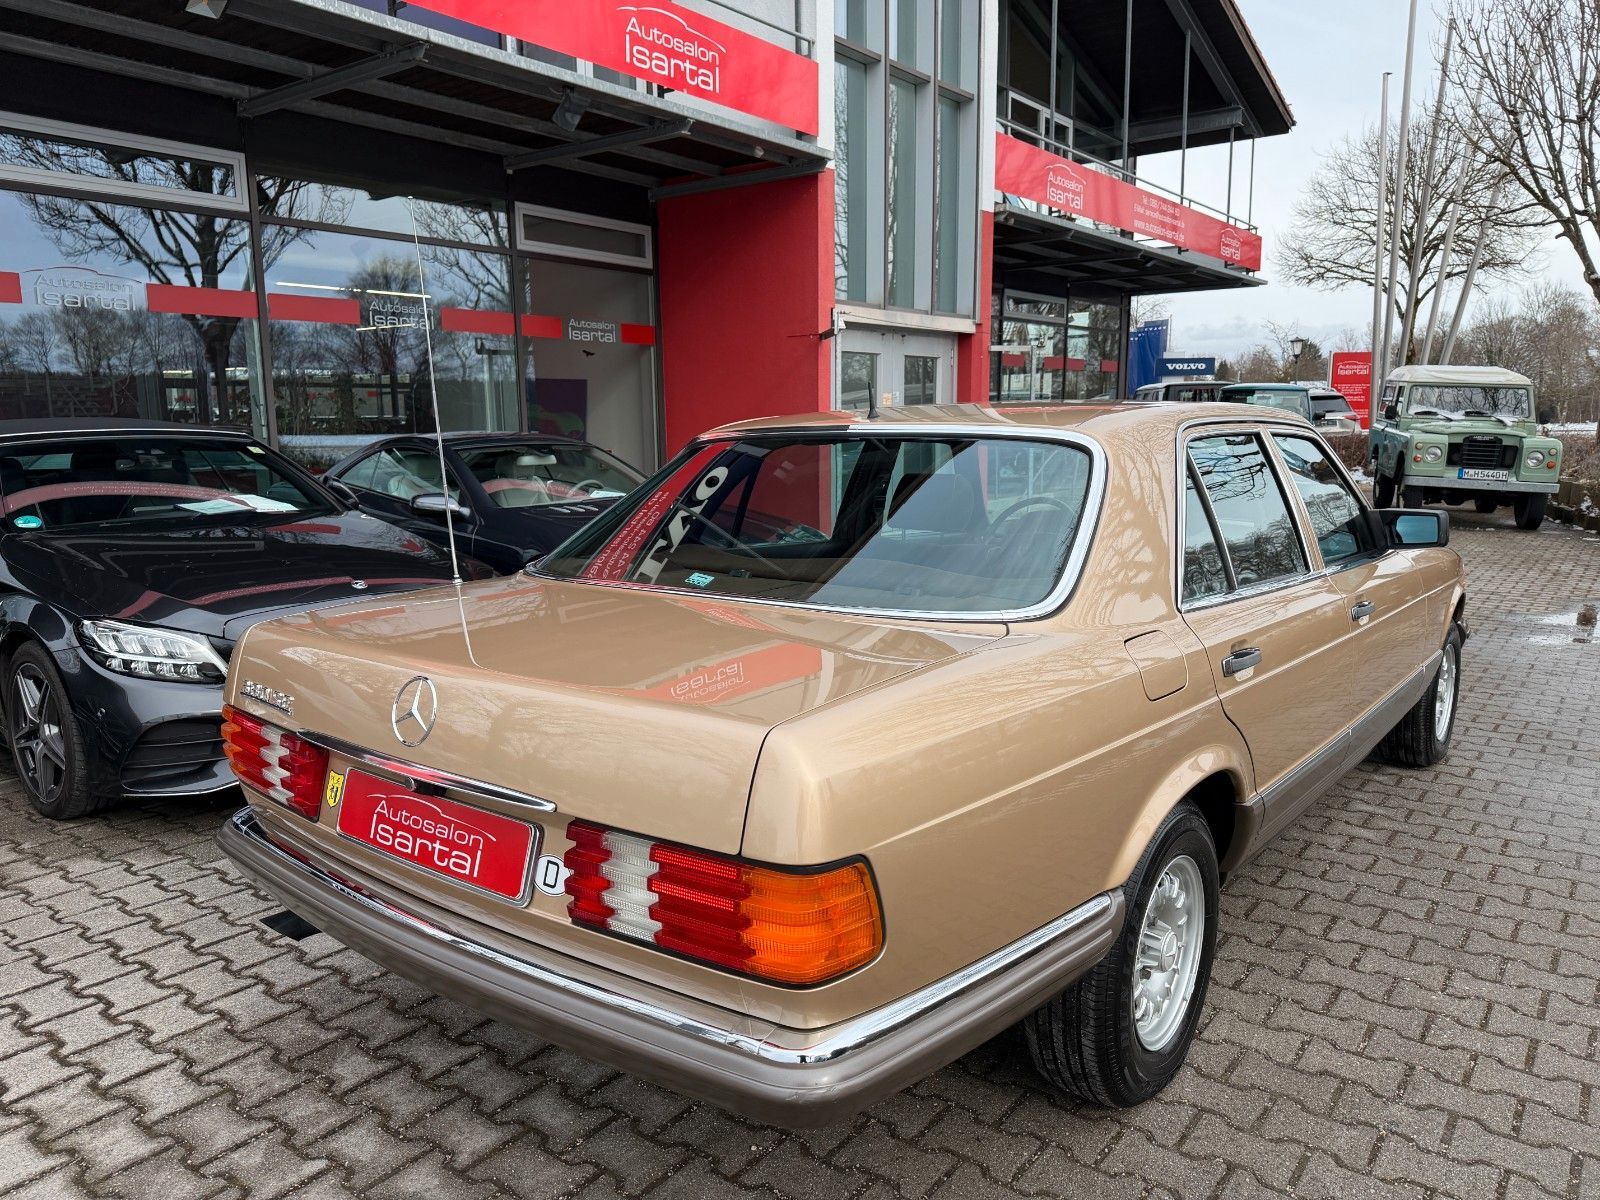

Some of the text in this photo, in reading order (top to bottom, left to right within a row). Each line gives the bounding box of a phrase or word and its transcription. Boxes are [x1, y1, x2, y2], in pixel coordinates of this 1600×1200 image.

[625, 16, 720, 66] Autosalon
[625, 34, 720, 94] Isartal
[1047, 171, 1084, 192] Autosalon
[1046, 180, 1084, 210] Isartal
[34, 274, 133, 293] Autosalon
[34, 286, 137, 311] Isartal
[369, 300, 434, 315] Autosalon
[369, 311, 435, 330] Isartal
[568, 318, 616, 331] Autosalon
[568, 327, 616, 343] Isartal
[1165, 362, 1207, 371] VOLVO
[374, 799, 484, 850] Autosalon
[369, 813, 483, 878] Isartal
[543, 859, 559, 889] D
